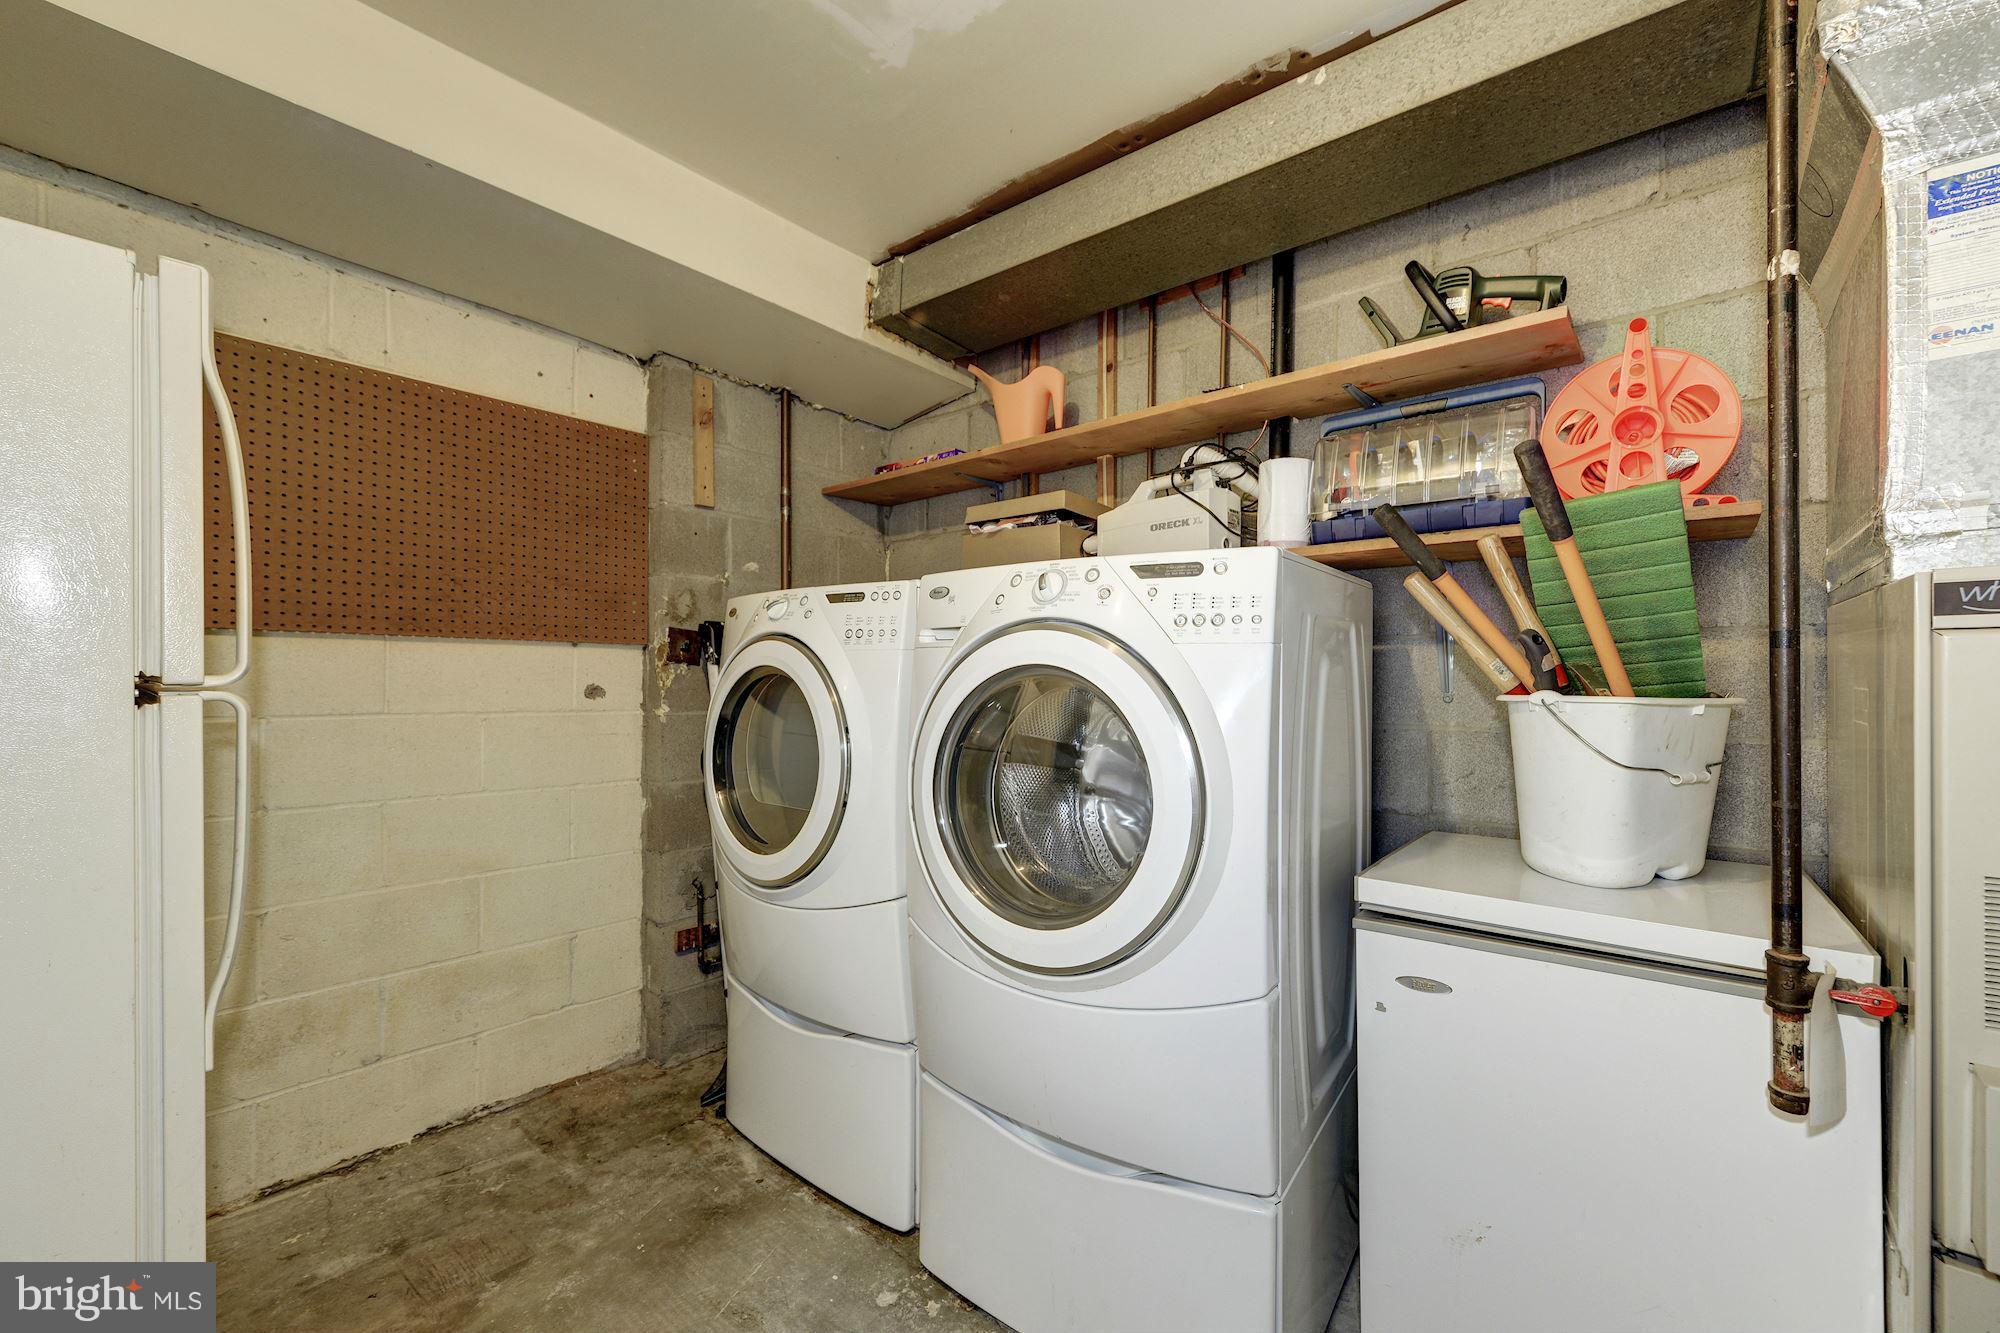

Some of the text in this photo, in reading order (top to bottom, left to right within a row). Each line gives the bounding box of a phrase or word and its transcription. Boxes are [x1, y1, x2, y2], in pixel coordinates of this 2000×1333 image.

[1934, 189, 1978, 207] Extended
[1930, 323, 1994, 340] EENAN
[1150, 518, 1190, 532] ORECK
